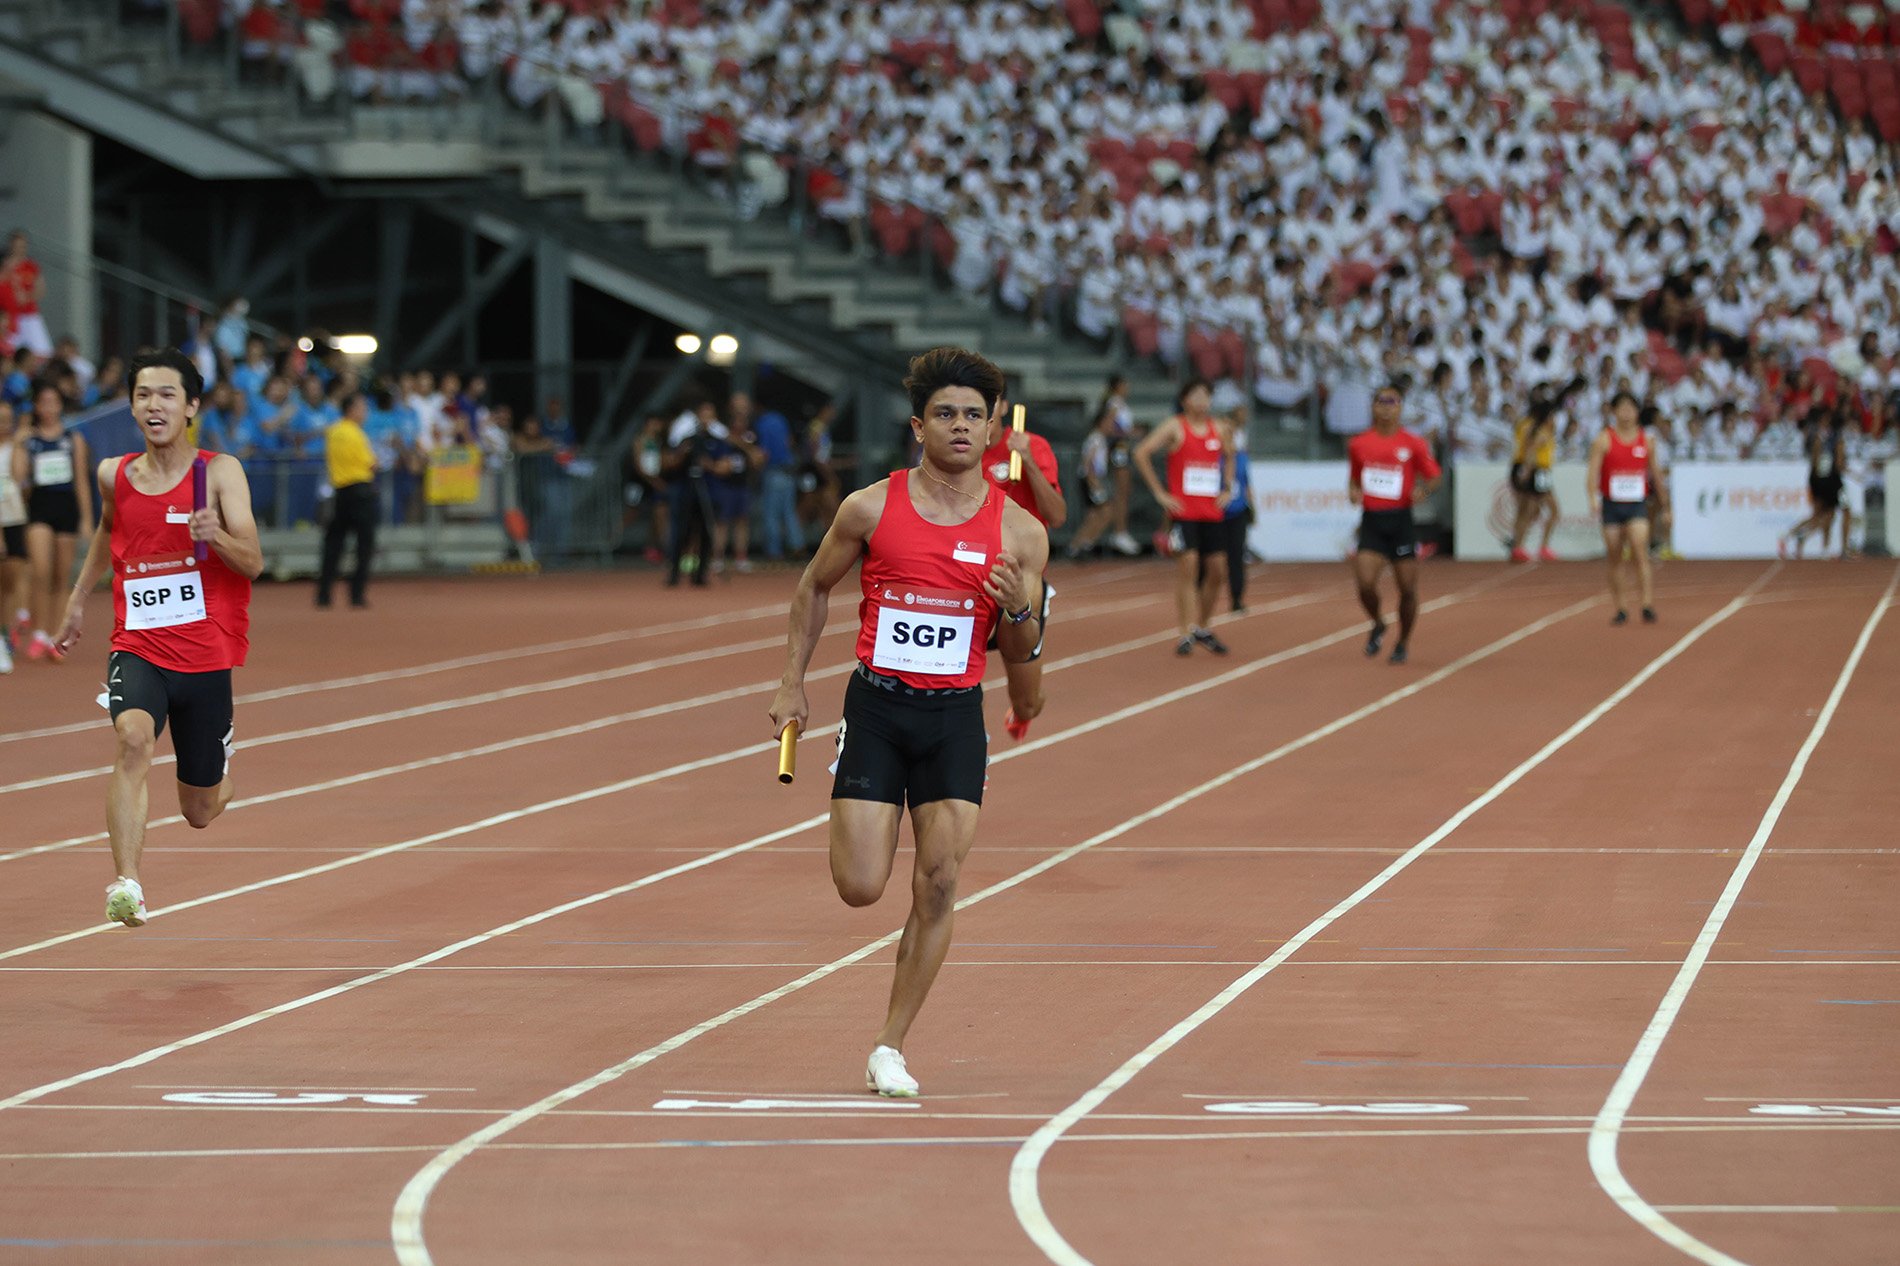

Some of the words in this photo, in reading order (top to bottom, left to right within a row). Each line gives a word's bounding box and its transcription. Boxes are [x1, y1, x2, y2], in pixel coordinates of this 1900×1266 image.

[131, 588, 171, 608] SGP
[180, 584, 196, 602] B
[892, 621, 957, 649] SGP
